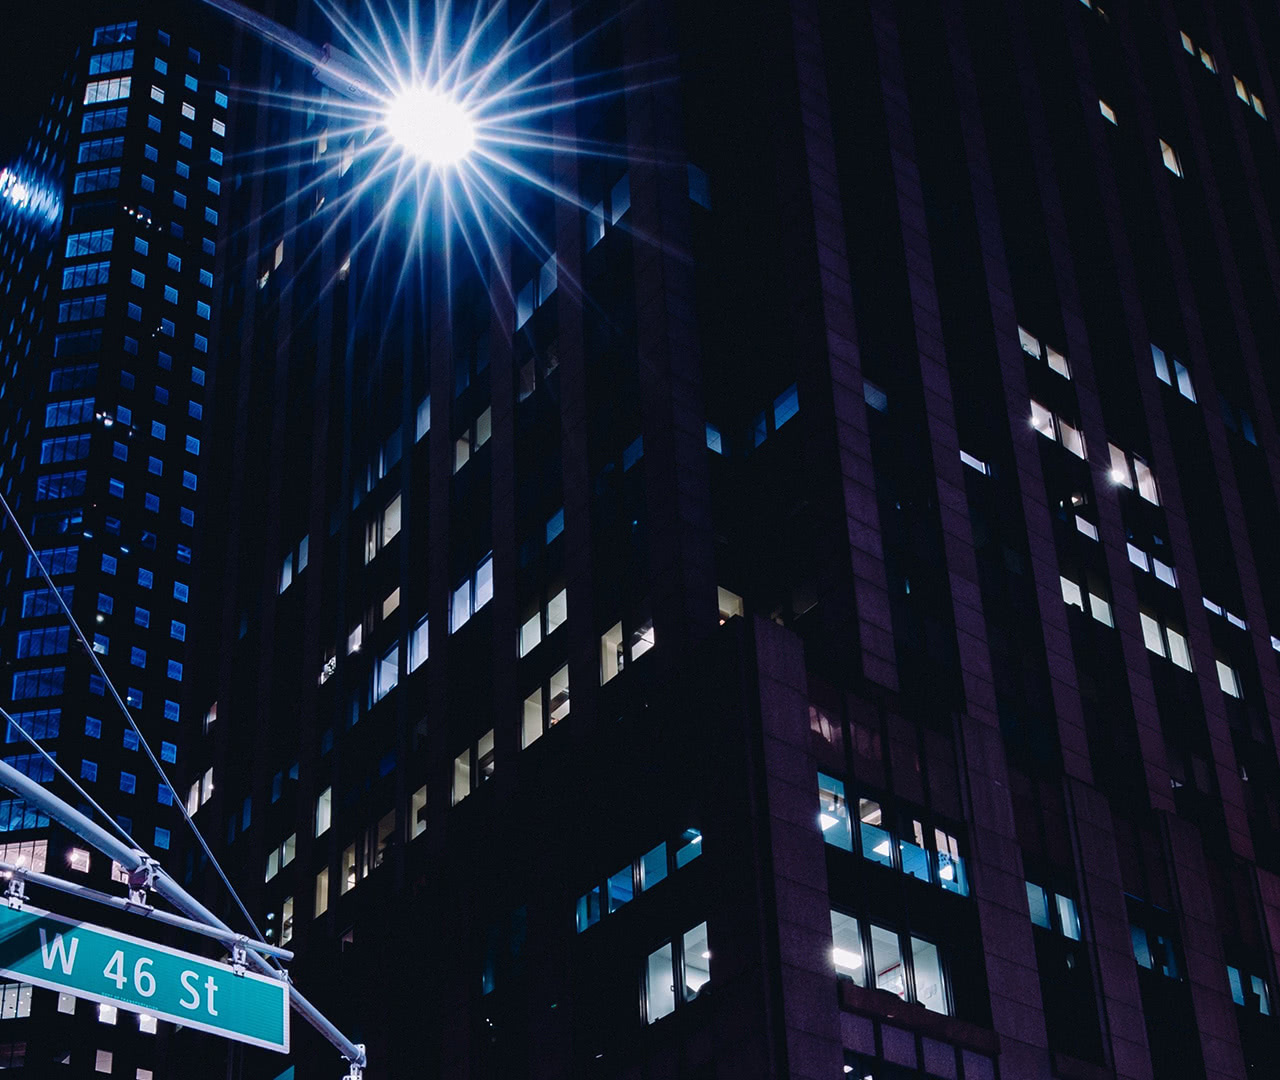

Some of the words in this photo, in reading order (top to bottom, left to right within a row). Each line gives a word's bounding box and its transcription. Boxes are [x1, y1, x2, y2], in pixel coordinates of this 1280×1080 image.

[39, 928, 79, 975] W
[103, 950, 157, 997] 46
[179, 970, 219, 1016] St
